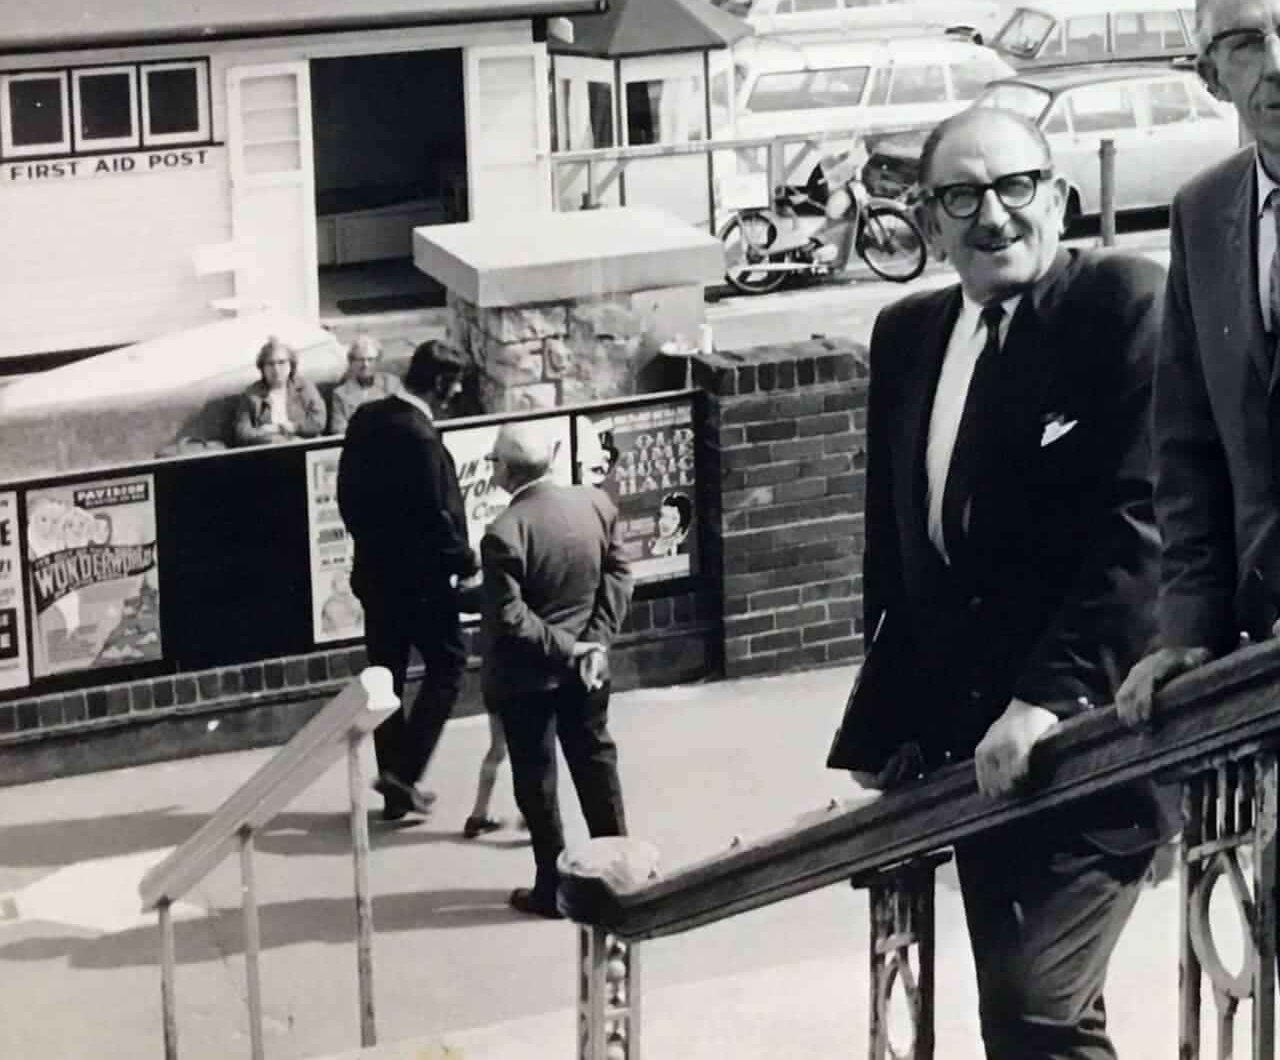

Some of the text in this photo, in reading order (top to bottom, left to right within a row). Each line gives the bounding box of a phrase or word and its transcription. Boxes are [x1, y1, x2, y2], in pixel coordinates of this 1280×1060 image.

[10, 150, 208, 181] FIRST AID POST
[636, 427, 695, 449] OLD
[623, 442, 695, 465] TIME
[614, 456, 695, 482] MUSIC
[77, 484, 146, 502] PAVILION
[618, 470, 695, 496] HALL
